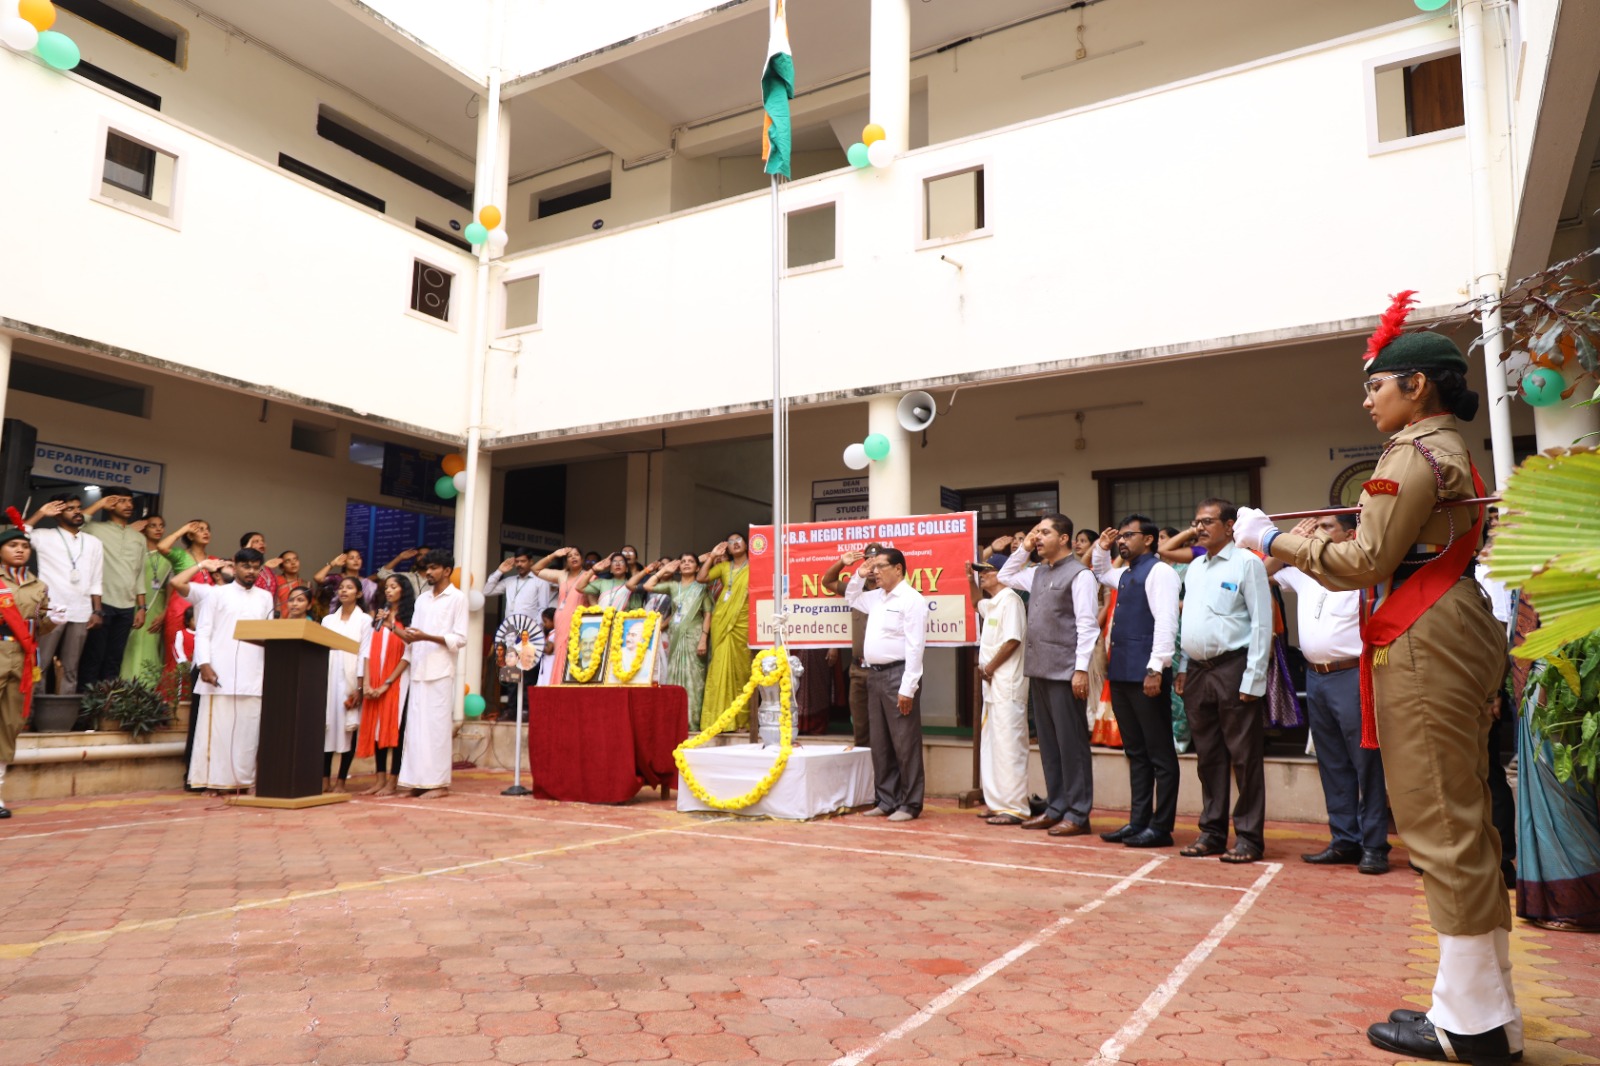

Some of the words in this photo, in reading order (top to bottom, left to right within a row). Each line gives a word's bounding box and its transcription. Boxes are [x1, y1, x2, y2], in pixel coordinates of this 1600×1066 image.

[37, 448, 130, 471] DEPARTMENT
[134, 465, 150, 474] OF
[54, 463, 132, 485] COMMERCE
[1369, 482, 1392, 492] NCC
[836, 505, 869, 514] STUDEN
[810, 527, 844, 543] HEGDE
[846, 524, 877, 541] FIRST
[878, 521, 916, 539] GRADE
[917, 518, 967, 536] COLLEGE
[837, 540, 895, 552] KUNDARA
[793, 603, 853, 616] Programm
